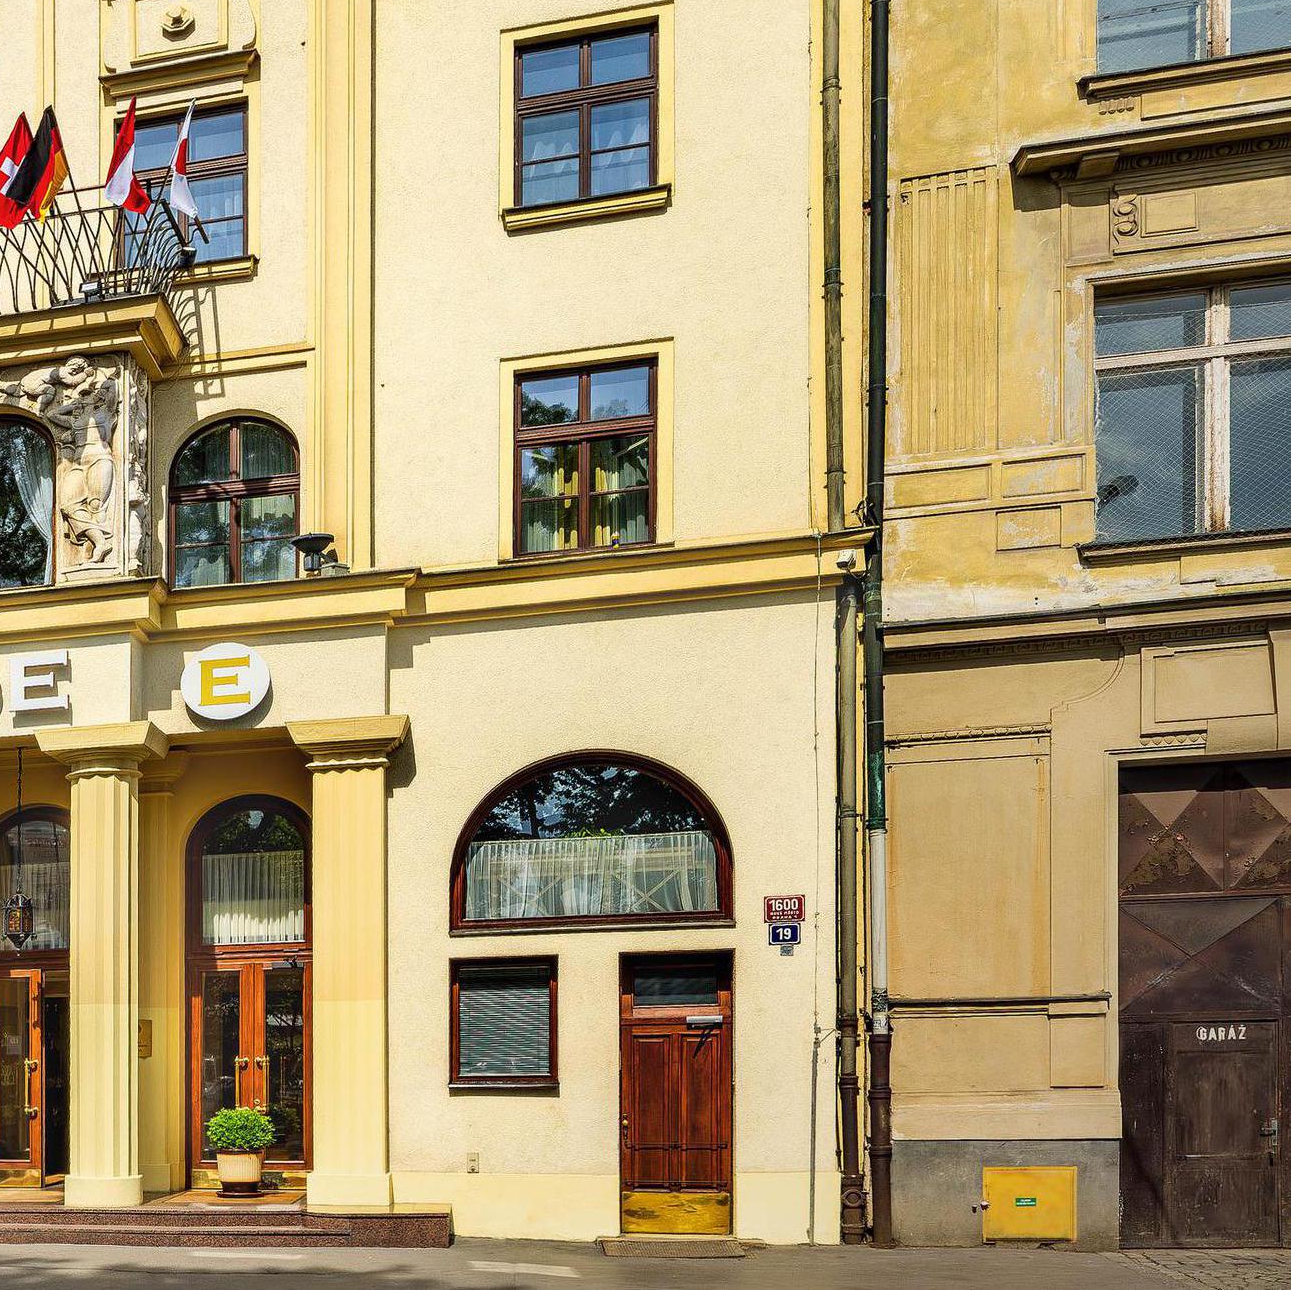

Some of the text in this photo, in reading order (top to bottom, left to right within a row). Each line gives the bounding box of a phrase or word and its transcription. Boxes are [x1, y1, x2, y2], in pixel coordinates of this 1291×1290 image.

[199, 653, 253, 707] E
[768, 898, 798, 911] 1600
[775, 928, 792, 940] 19
